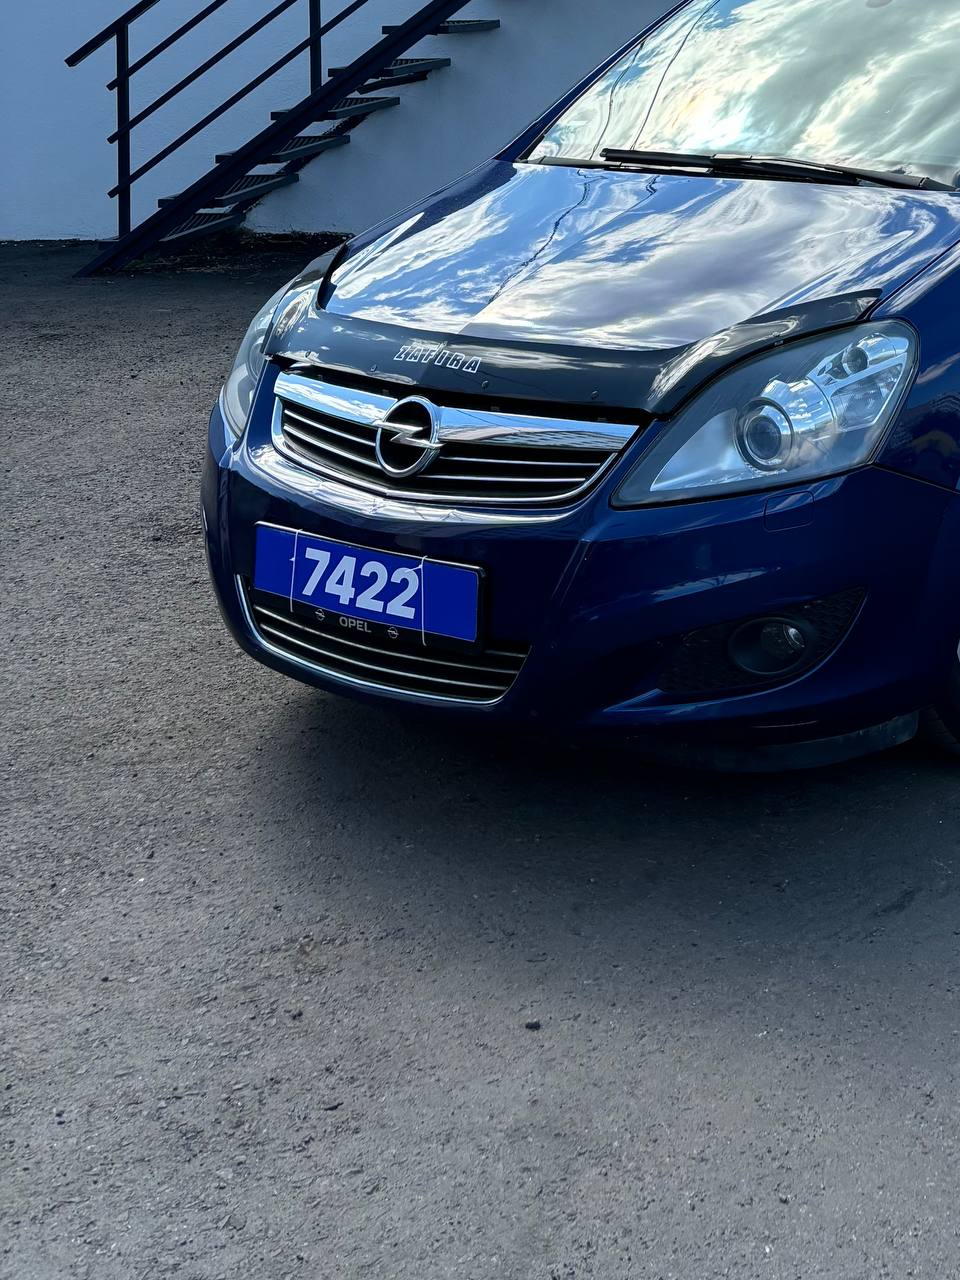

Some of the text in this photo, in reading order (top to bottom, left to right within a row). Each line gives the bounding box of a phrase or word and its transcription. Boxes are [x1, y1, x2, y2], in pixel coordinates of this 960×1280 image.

[393, 344, 482, 374] ZAFIRA
[302, 547, 420, 620] 7422
[339, 616, 372, 633] OPEL
